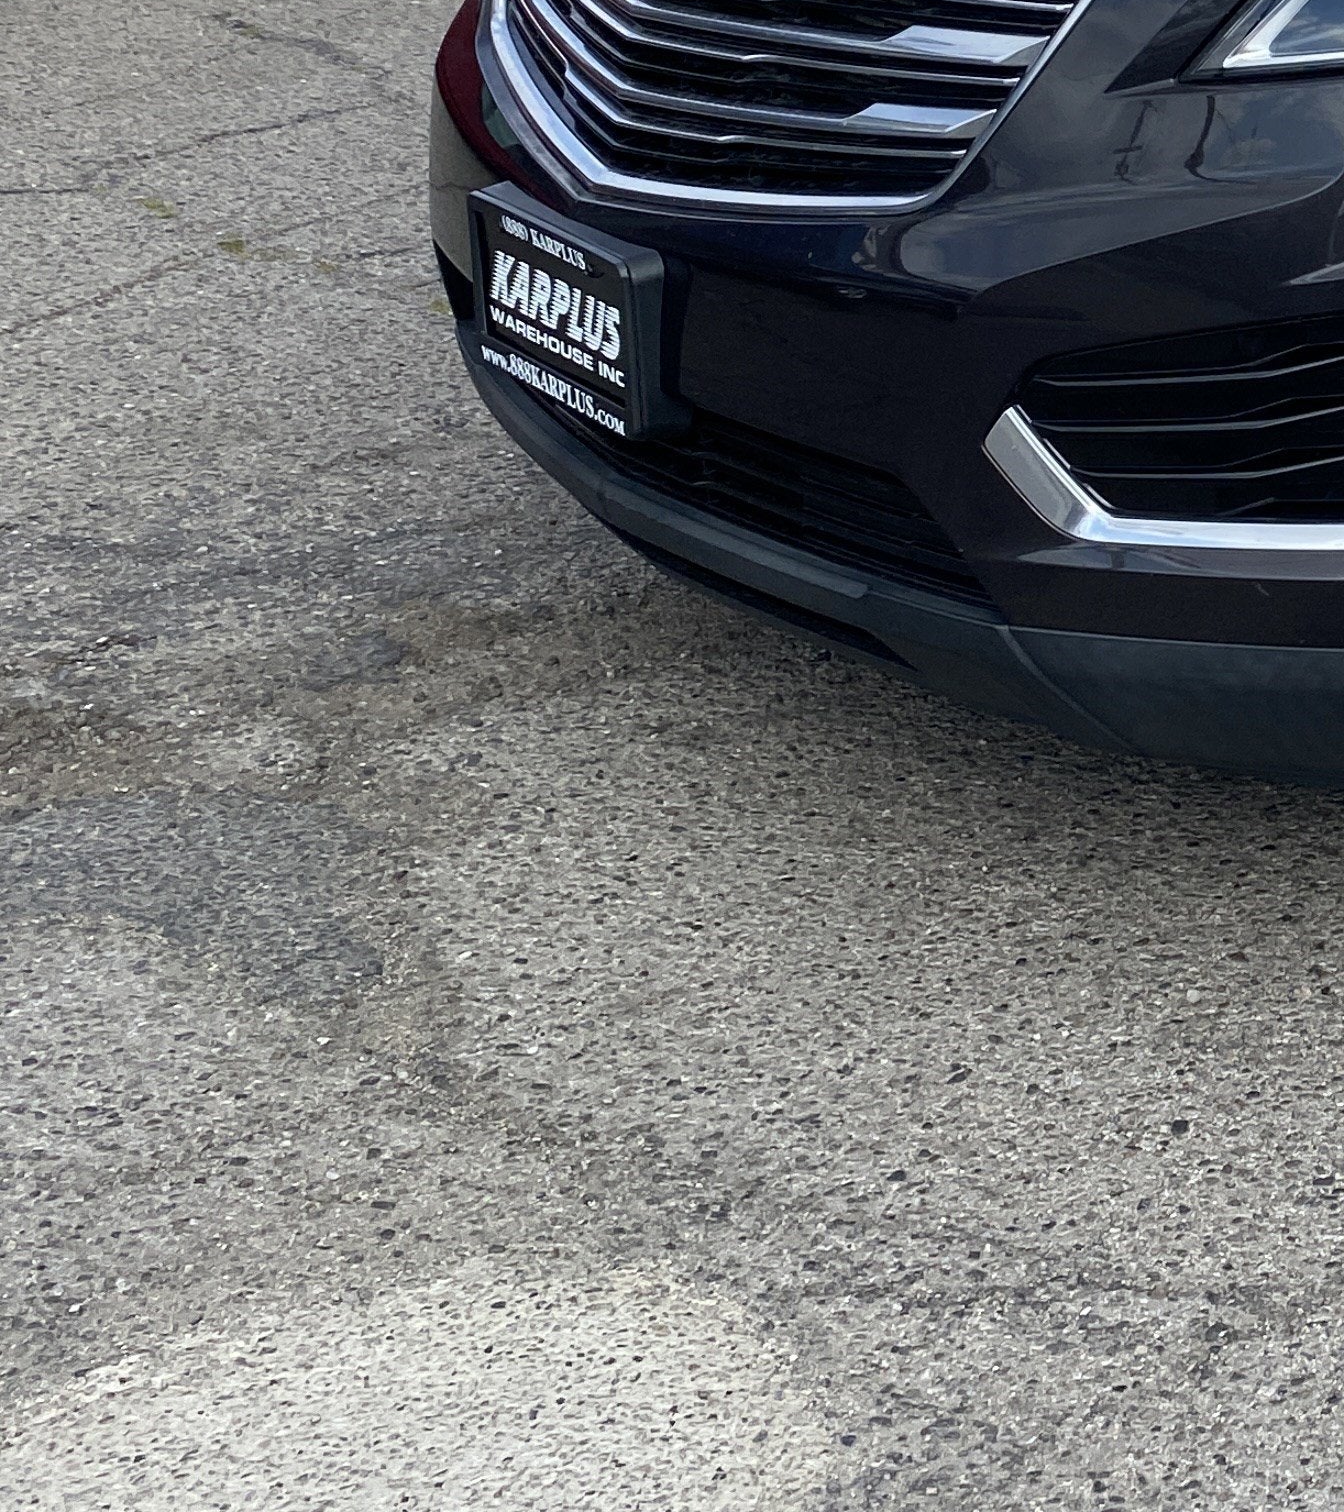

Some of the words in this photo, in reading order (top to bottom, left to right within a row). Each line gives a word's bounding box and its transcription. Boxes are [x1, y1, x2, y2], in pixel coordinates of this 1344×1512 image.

[529, 228, 586, 271] KARPLUS
[489, 305, 594, 371] WAREHOUSE
[598, 360, 626, 388] INC
[490, 250, 621, 360] KARPLUS
